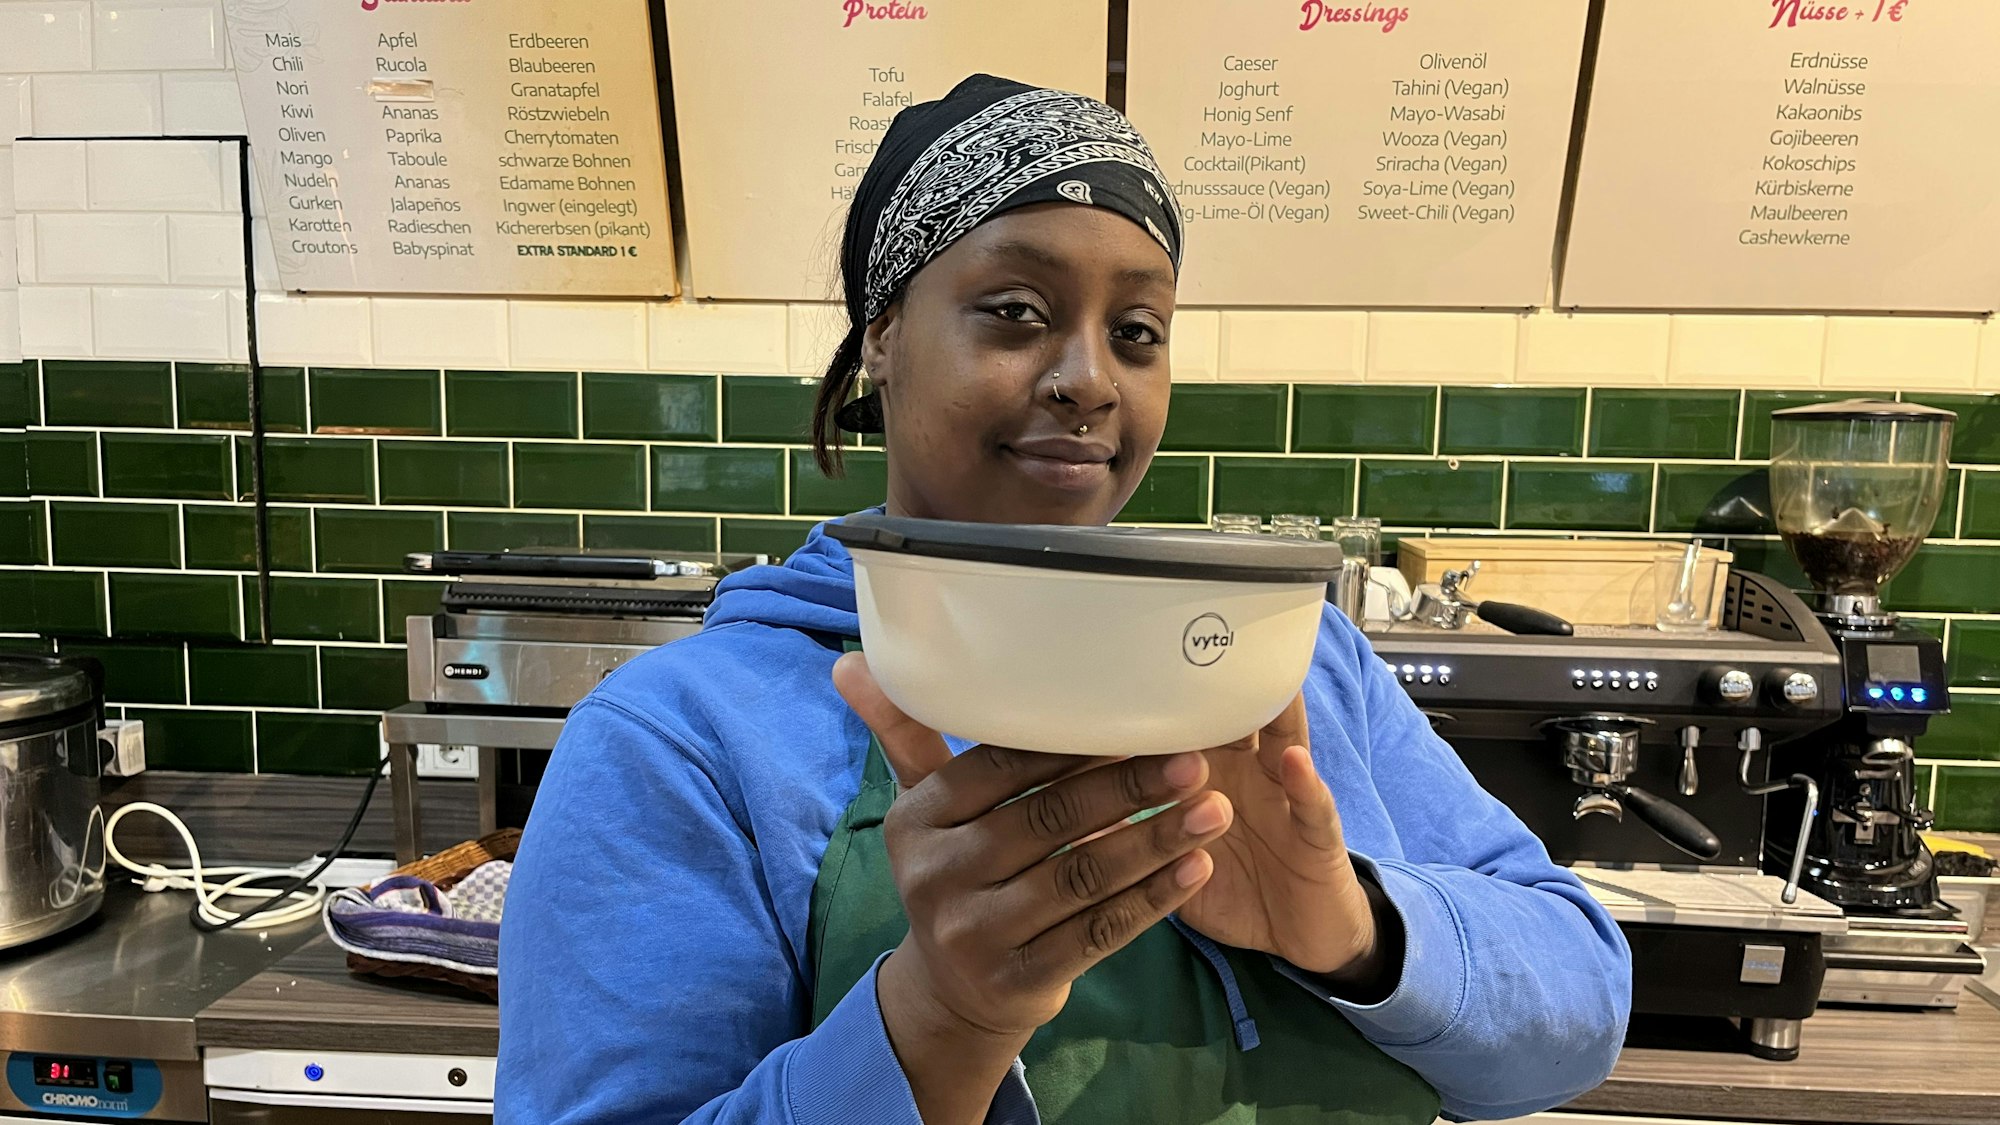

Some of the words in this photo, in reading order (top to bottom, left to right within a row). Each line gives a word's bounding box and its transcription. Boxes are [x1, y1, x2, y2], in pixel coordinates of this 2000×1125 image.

[843, 0, 928, 28] Protein
[1299, 0, 1409, 33] Dressings
[1768, 0, 1848, 28] Nüsse
[265, 33, 301, 47] Mais
[378, 33, 417, 50] Apfel
[509, 33, 589, 48] Erdbeeren
[273, 56, 303, 71] Chili
[376, 56, 427, 72] Rucola
[509, 57, 595, 73] Blaubeeren
[1224, 56, 1279, 71] Caeser
[1420, 52, 1487, 69] Olivenöl
[1791, 51, 1868, 69] Erdnüsse
[868, 67, 904, 82] Tofu
[276, 81, 309, 95] Nori
[511, 82, 599, 100] Granatapfel
[1219, 80, 1279, 100] Joghurt
[1392, 79, 1440, 96] Tahini
[1445, 78, 1509, 99] (Vegan)
[1785, 77, 1865, 95] Walnüsse
[862, 91, 913, 107] Falafel
[281, 104, 313, 118] Kiwi
[382, 106, 438, 120] Ananas
[508, 106, 609, 121] Röstzwiebeln
[1204, 106, 1251, 126] Honig
[1256, 105, 1294, 121] Senf
[1391, 104, 1505, 125] Mayo-Wasabi
[1776, 103, 1862, 121] Kakaonibs
[279, 127, 326, 142] Oliven
[386, 128, 442, 146] Paprika
[504, 129, 619, 148] Cherrytomaten
[1201, 131, 1292, 150] Mayo-Lime
[1383, 131, 1439, 146] Wooza
[1444, 130, 1507, 150] (Vegan)
[1770, 129, 1858, 149] Gojibeeren
[281, 151, 332, 168] Mango
[387, 151, 447, 166] Taboule
[499, 152, 569, 167] schwarze
[573, 153, 631, 168] Bohnen
[1184, 155, 1305, 175] Cocktail(Pikant)
[1376, 155, 1439, 171] Sriracha
[1444, 155, 1507, 175] (Vegan)
[1763, 154, 1856, 175] Kokoschips
[284, 173, 338, 187] Nudeln
[395, 175, 450, 189] Ananas
[500, 175, 574, 190] Edamame
[578, 176, 635, 191] Bohnen
[1755, 179, 1853, 196] Kürbiskerne
[1269, 180, 1330, 199] (Vegan)
[1363, 181, 1448, 199] Soya-Lime
[1452, 180, 1514, 199] (Vegan)
[289, 195, 343, 210] Gurken
[391, 196, 461, 214] Jalapeños
[503, 199, 556, 216] Ingwer
[559, 198, 637, 217] (eingelegt)
[1269, 204, 1329, 223] (Vegan)
[1358, 204, 1448, 219] Sweet-Chili
[1453, 204, 1514, 224] (Vegan)
[1751, 204, 1847, 221] Maulbeeren
[289, 218, 352, 232] Karotten
[388, 219, 471, 234] Radieschen
[496, 220, 591, 235] Kichererbsen
[595, 221, 650, 239] (pikant)
[1739, 229, 1850, 245] Cashewkerne
[292, 240, 358, 254] Croutons
[393, 241, 475, 260] Babyspinat
[517, 245, 555, 256] EXTRA
[557, 245, 618, 257] STANDARD
[1192, 631, 1234, 650] vytal
[51, 1063, 69, 1079] 31
